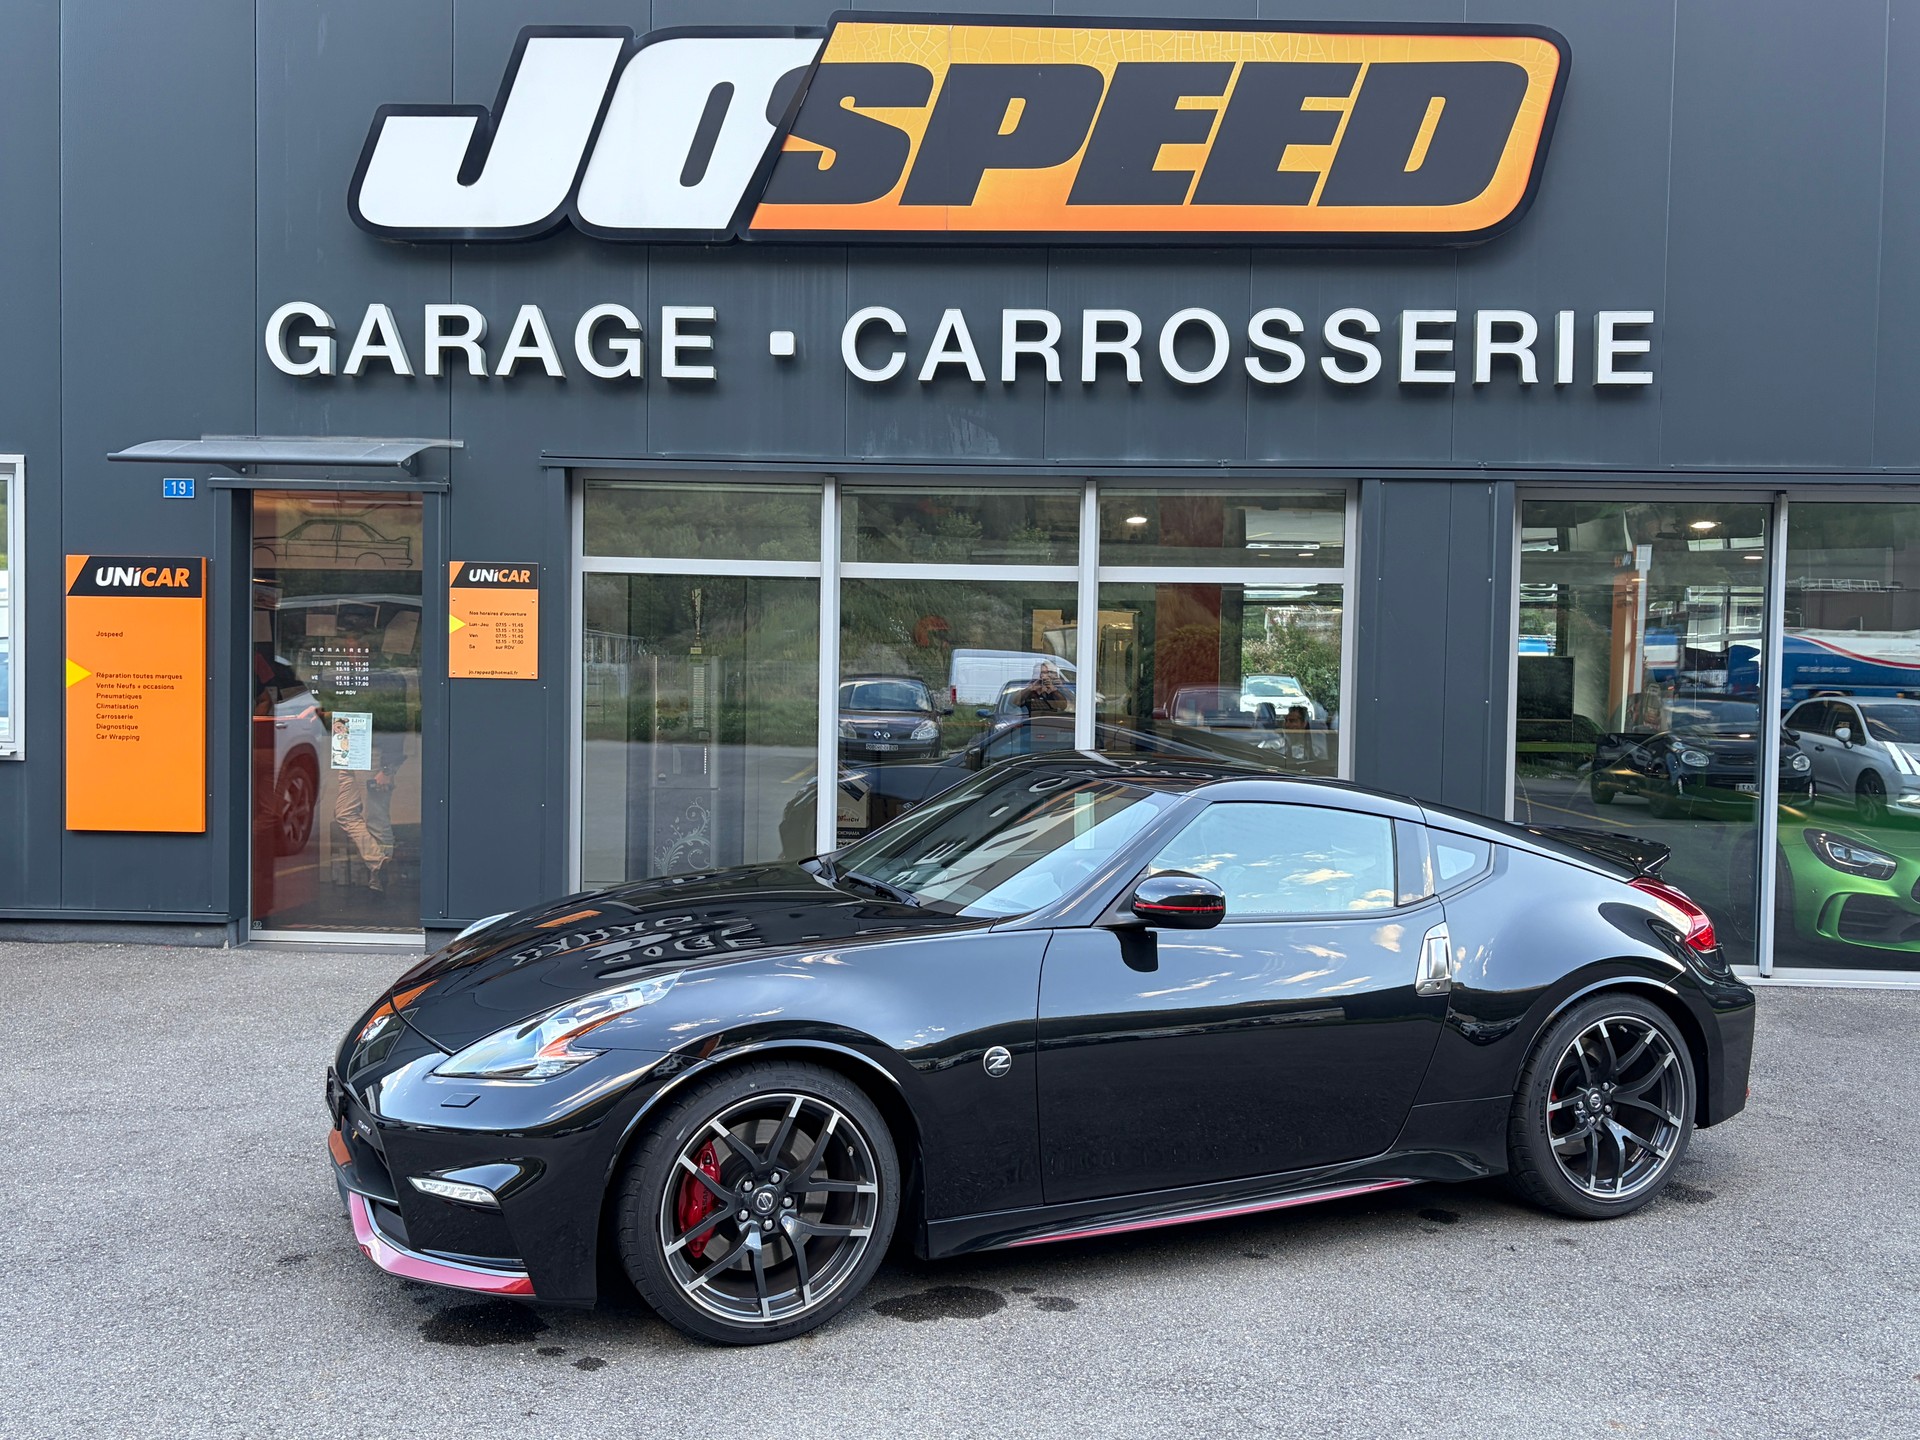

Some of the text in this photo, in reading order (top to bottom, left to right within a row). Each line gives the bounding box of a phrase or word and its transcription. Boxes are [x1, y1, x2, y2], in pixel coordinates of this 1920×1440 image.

[265, 301, 1655, 386] GARAGE CARROSSERIE
[171, 481, 186, 495] 19
[96, 672, 132, 680] Réparation
[96, 692, 143, 700] Pneumatiques
[96, 723, 139, 731] Diagnostique
[109, 734, 141, 742] Wrapping
